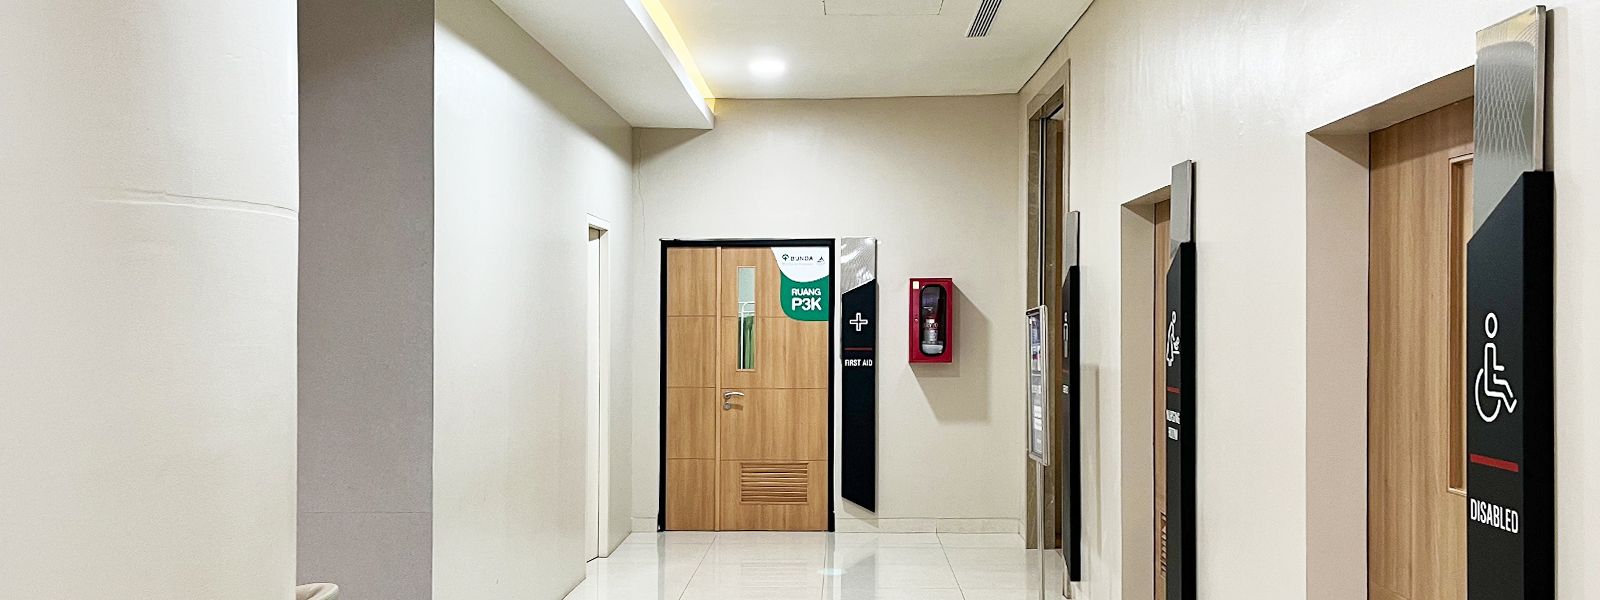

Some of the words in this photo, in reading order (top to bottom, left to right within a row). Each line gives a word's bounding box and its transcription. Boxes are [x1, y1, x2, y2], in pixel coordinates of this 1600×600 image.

[791, 288, 822, 296] RUANG
[791, 298, 822, 311] P3K
[844, 359, 861, 367] FIRST
[862, 359, 873, 367] AID
[1470, 498, 1519, 534] DISABLED
